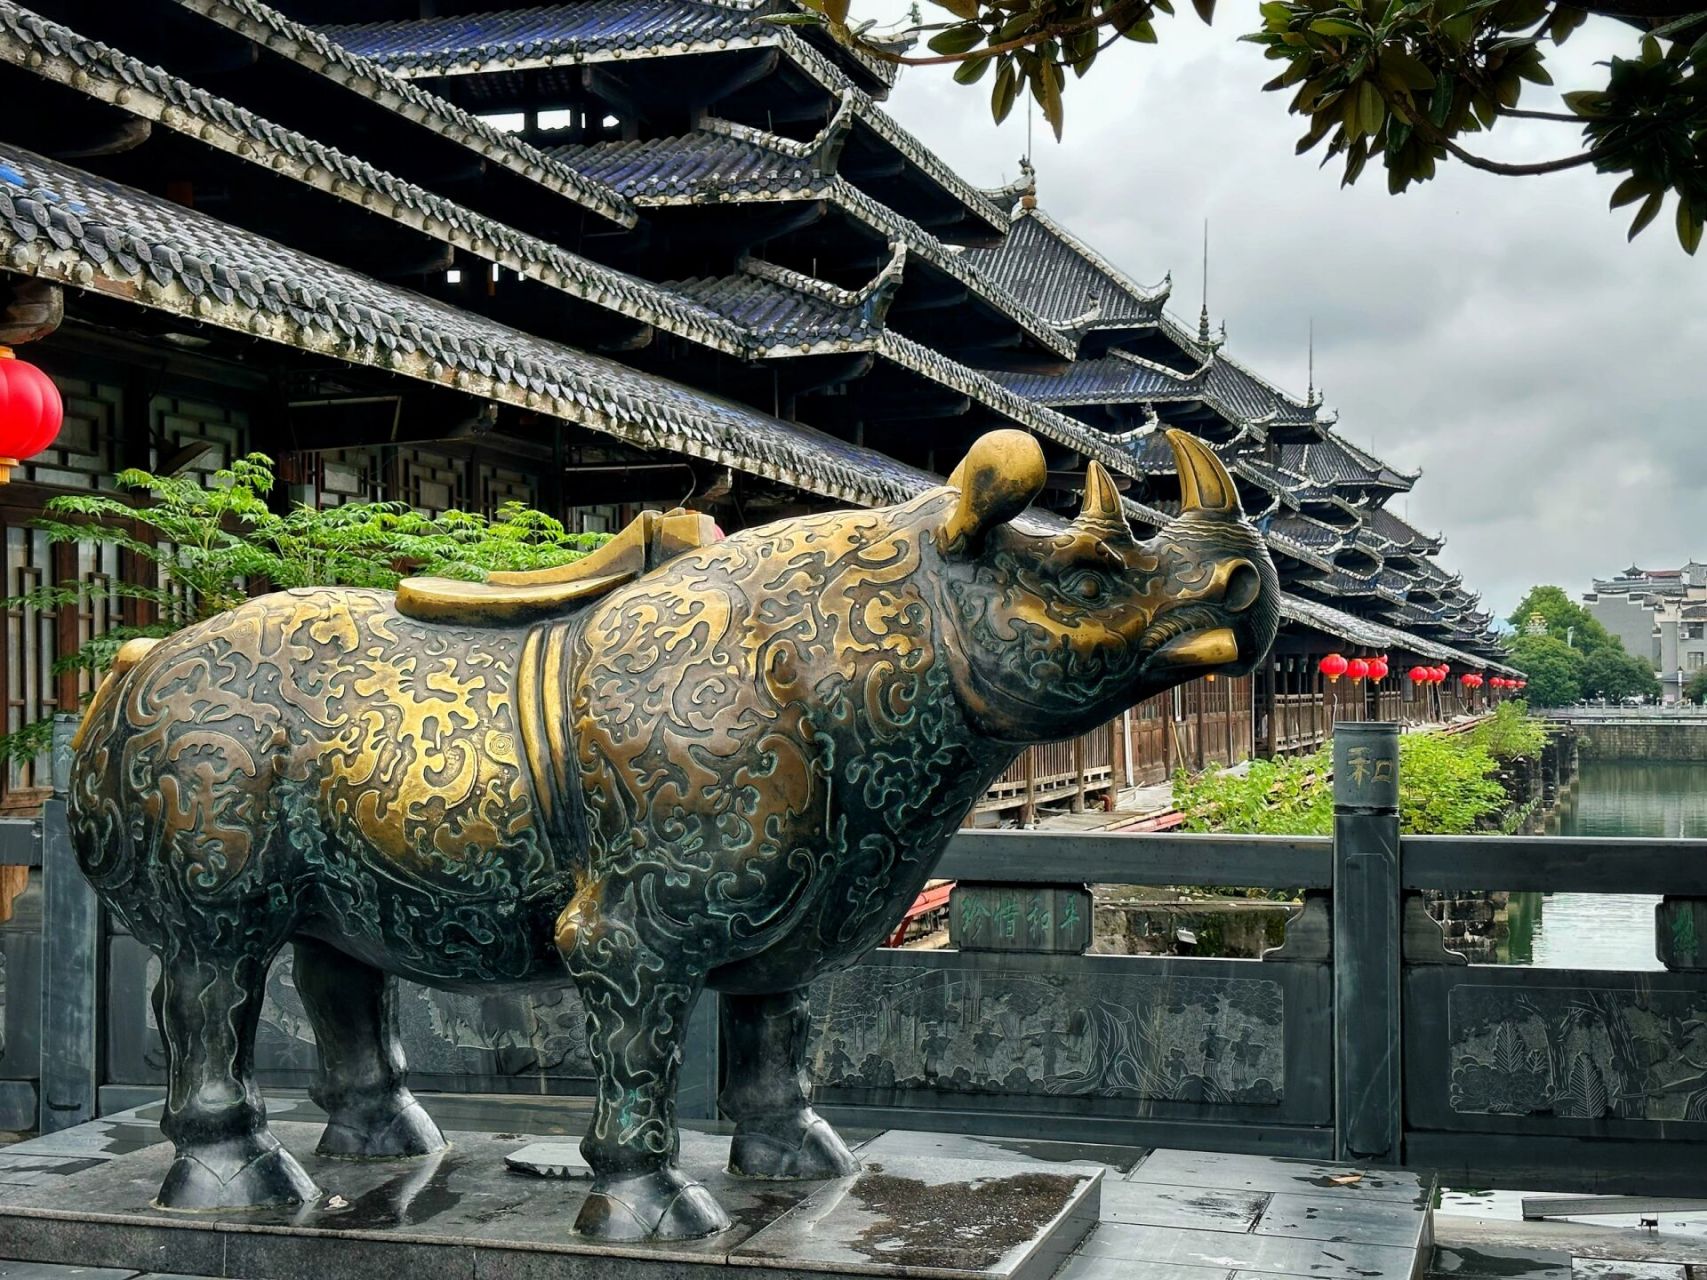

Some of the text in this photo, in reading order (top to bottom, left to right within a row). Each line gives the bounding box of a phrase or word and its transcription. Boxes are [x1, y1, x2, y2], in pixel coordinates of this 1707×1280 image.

[1346, 746, 1393, 788] 和
[961, 894, 1080, 942] 珍惜和平
